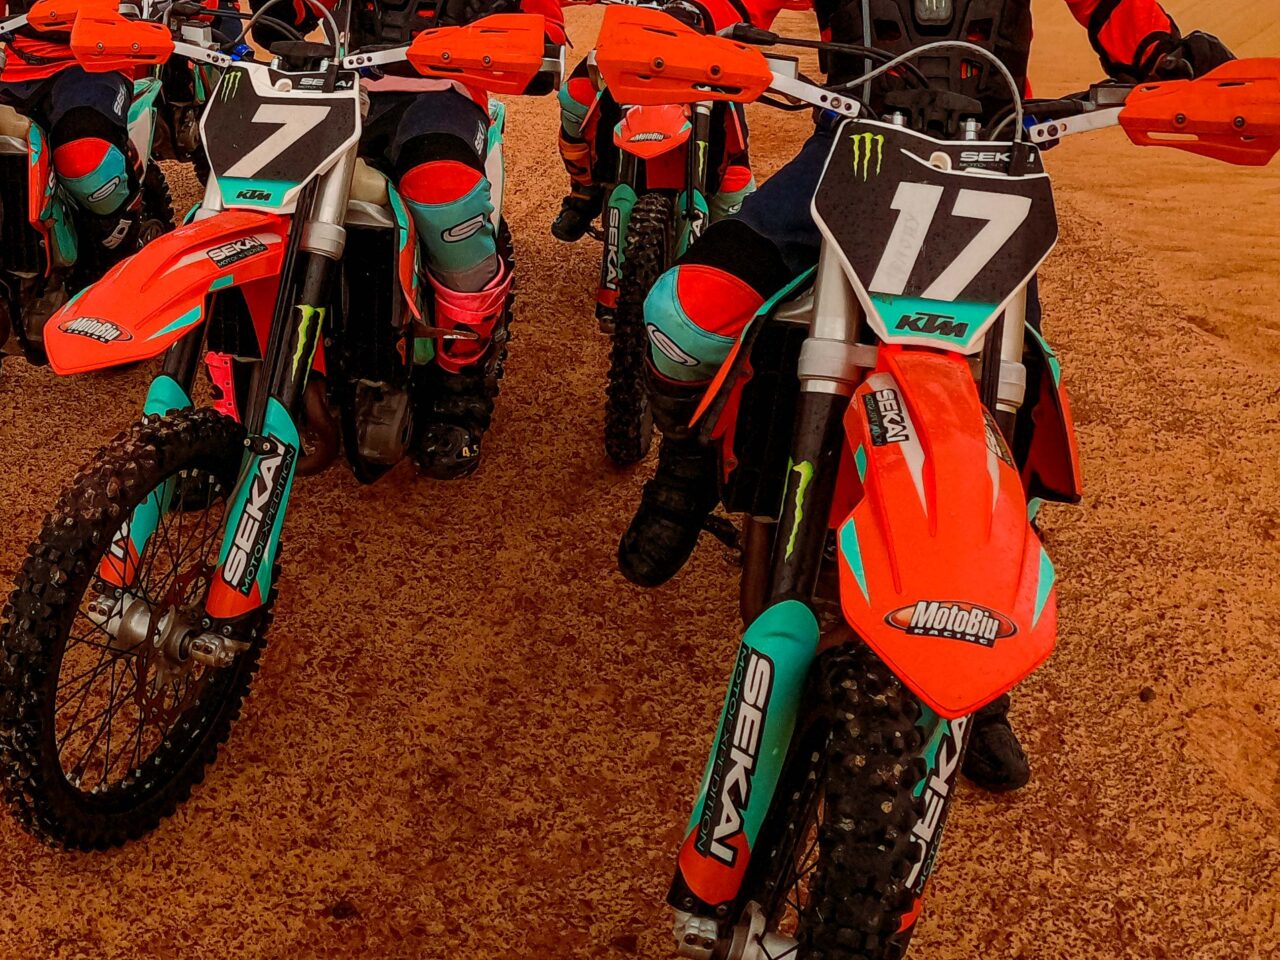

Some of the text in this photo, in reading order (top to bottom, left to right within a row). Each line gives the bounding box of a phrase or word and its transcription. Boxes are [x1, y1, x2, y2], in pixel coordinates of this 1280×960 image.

[299, 77, 353, 88] SEAI
[221, 103, 332, 178] 7
[960, 151, 1036, 163] SEKI
[235, 189, 272, 202] KTM
[207, 236, 262, 261] SEKAI
[605, 208, 619, 290] SEKAI
[867, 181, 1033, 302] 17
[894, 311, 970, 339] KTM
[875, 389, 908, 442] SEKAI
[223, 436, 286, 586] SEKAI
[241, 447, 296, 593] MOTOEXPEDITION
[910, 601, 1000, 640] MotoBiu
[913, 628, 989, 645] RACING
[697, 646, 748, 852] MOTOEXPEDITION
[709, 653, 771, 863] SEKAI
